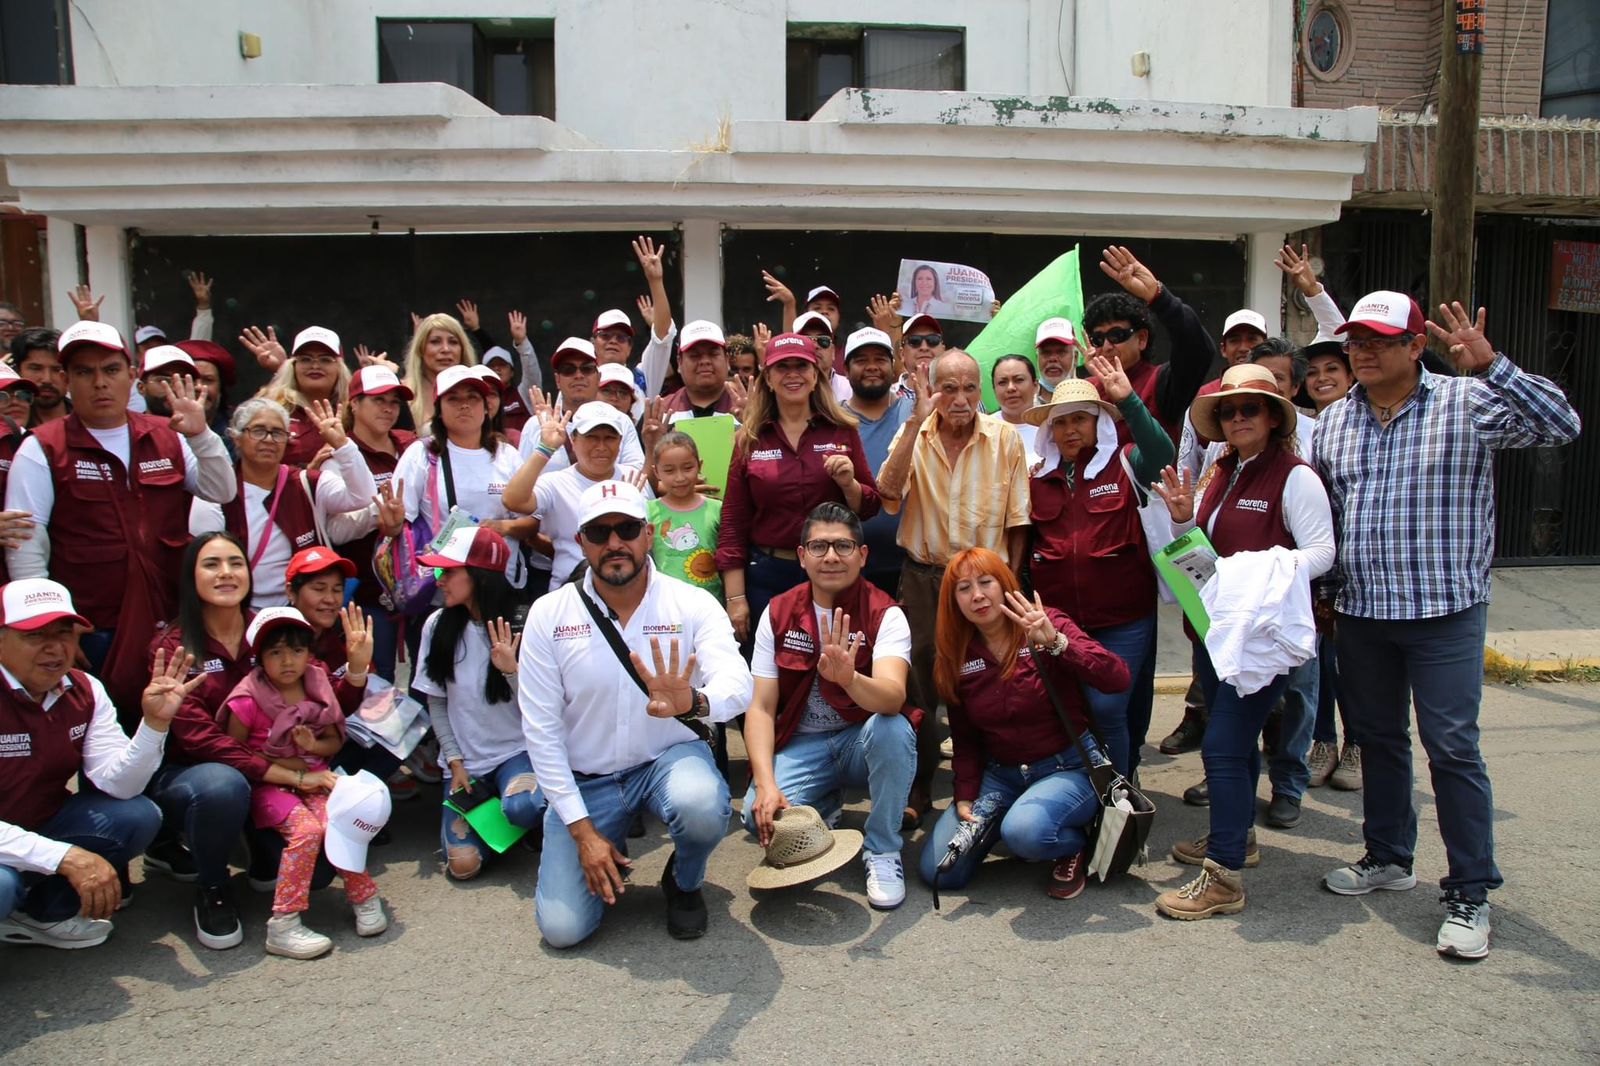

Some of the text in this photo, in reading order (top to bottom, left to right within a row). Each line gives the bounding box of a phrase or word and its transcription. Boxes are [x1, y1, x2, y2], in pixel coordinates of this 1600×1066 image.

[774, 337, 804, 347] morena
[75, 460, 111, 470] JUANTA
[138, 458, 172, 470] morena
[602, 484, 616, 498] H
[1089, 483, 1119, 495] morena
[1237, 498, 1268, 510] morena
[24, 591, 63, 601] JUANITA
[553, 624, 591, 633] JUANITA
[642, 624, 670, 632] morena
[552, 630, 591, 639] PRESIDENTA
[783, 637, 814, 650] PRESIDENTA
